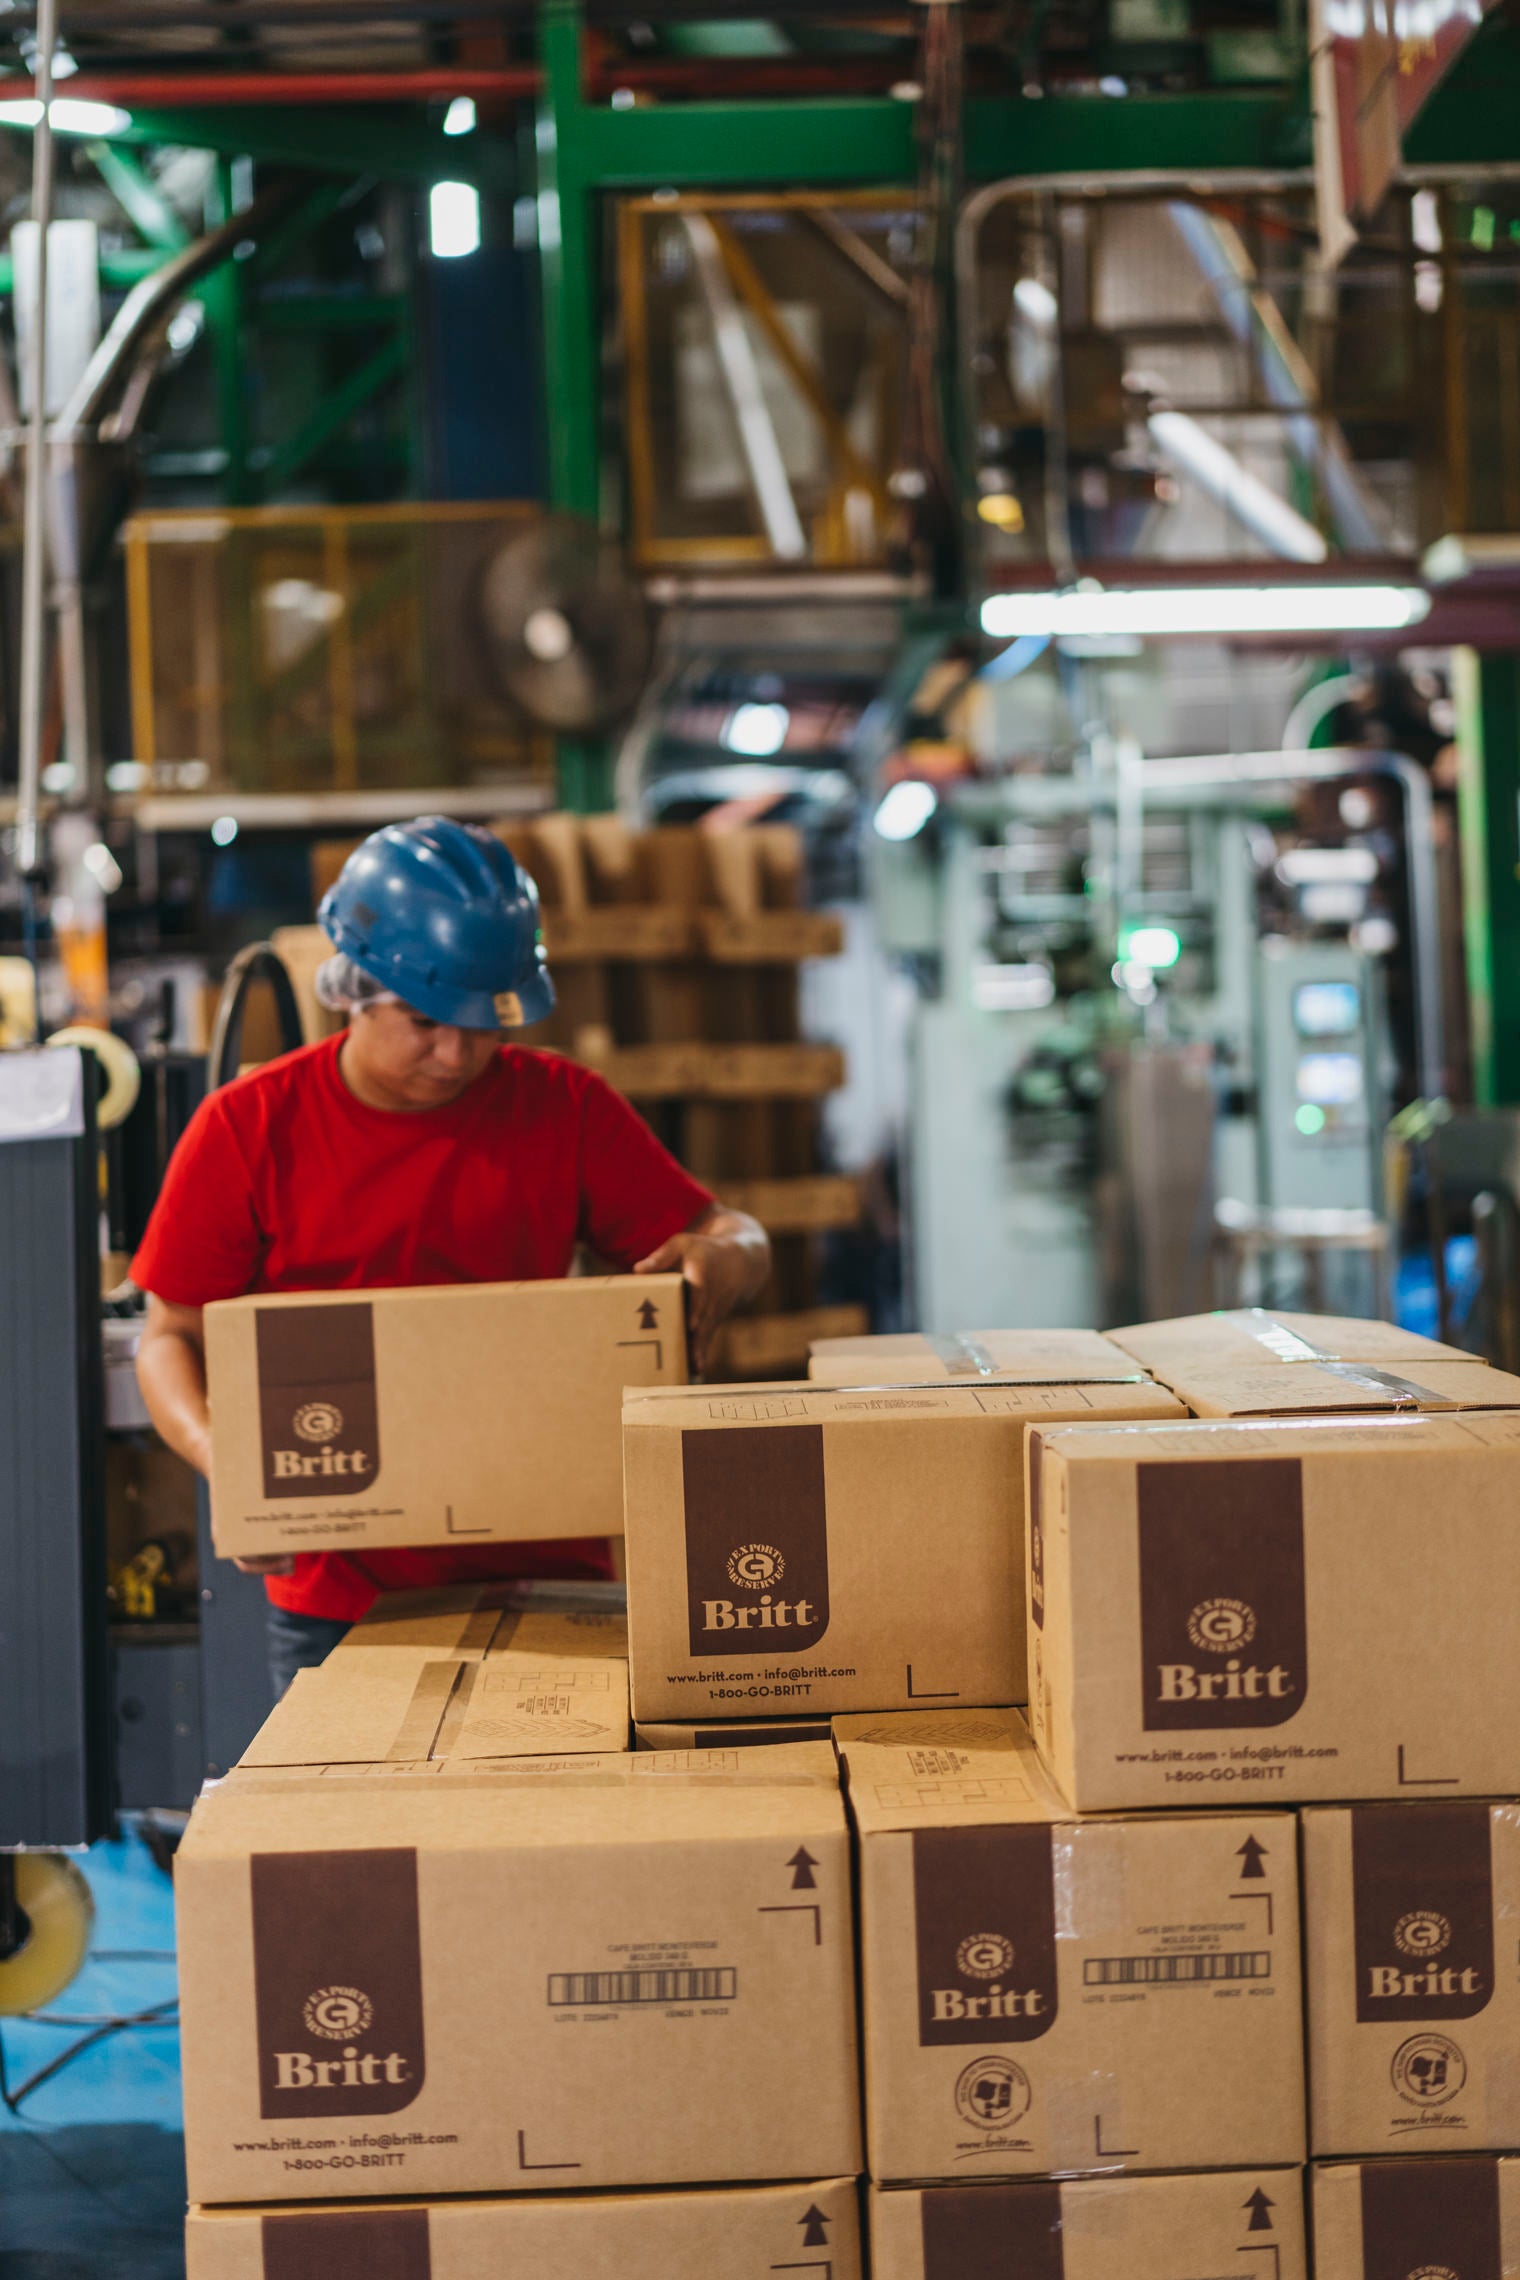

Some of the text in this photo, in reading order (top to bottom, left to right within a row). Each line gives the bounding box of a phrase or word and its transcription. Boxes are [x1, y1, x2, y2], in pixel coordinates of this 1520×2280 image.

[272, 1446, 367, 1479] Britt
[731, 1543, 782, 1560] EXPORT
[728, 1570, 784, 1590] RESERVE
[701, 1594, 815, 1631] Britt
[667, 1666, 857, 1683] www.britt.com info@britt.com
[1156, 1659, 1290, 1701] Britt
[709, 1683, 812, 1700] 1-800-GO-BRITT
[1116, 1745, 1339, 1762] www.britt.com info@britt.com
[1165, 1765, 1286, 1782] 1-800-GO-BRITT
[1368, 1962, 1479, 1998] Britt
[931, 1984, 1043, 2020] Britt
[272, 2046, 408, 2089] Britt
[233, 2132, 459, 2151] www.britt.com info@britt.com
[282, 2152, 406, 2171] 1-800-GO-BRITT
